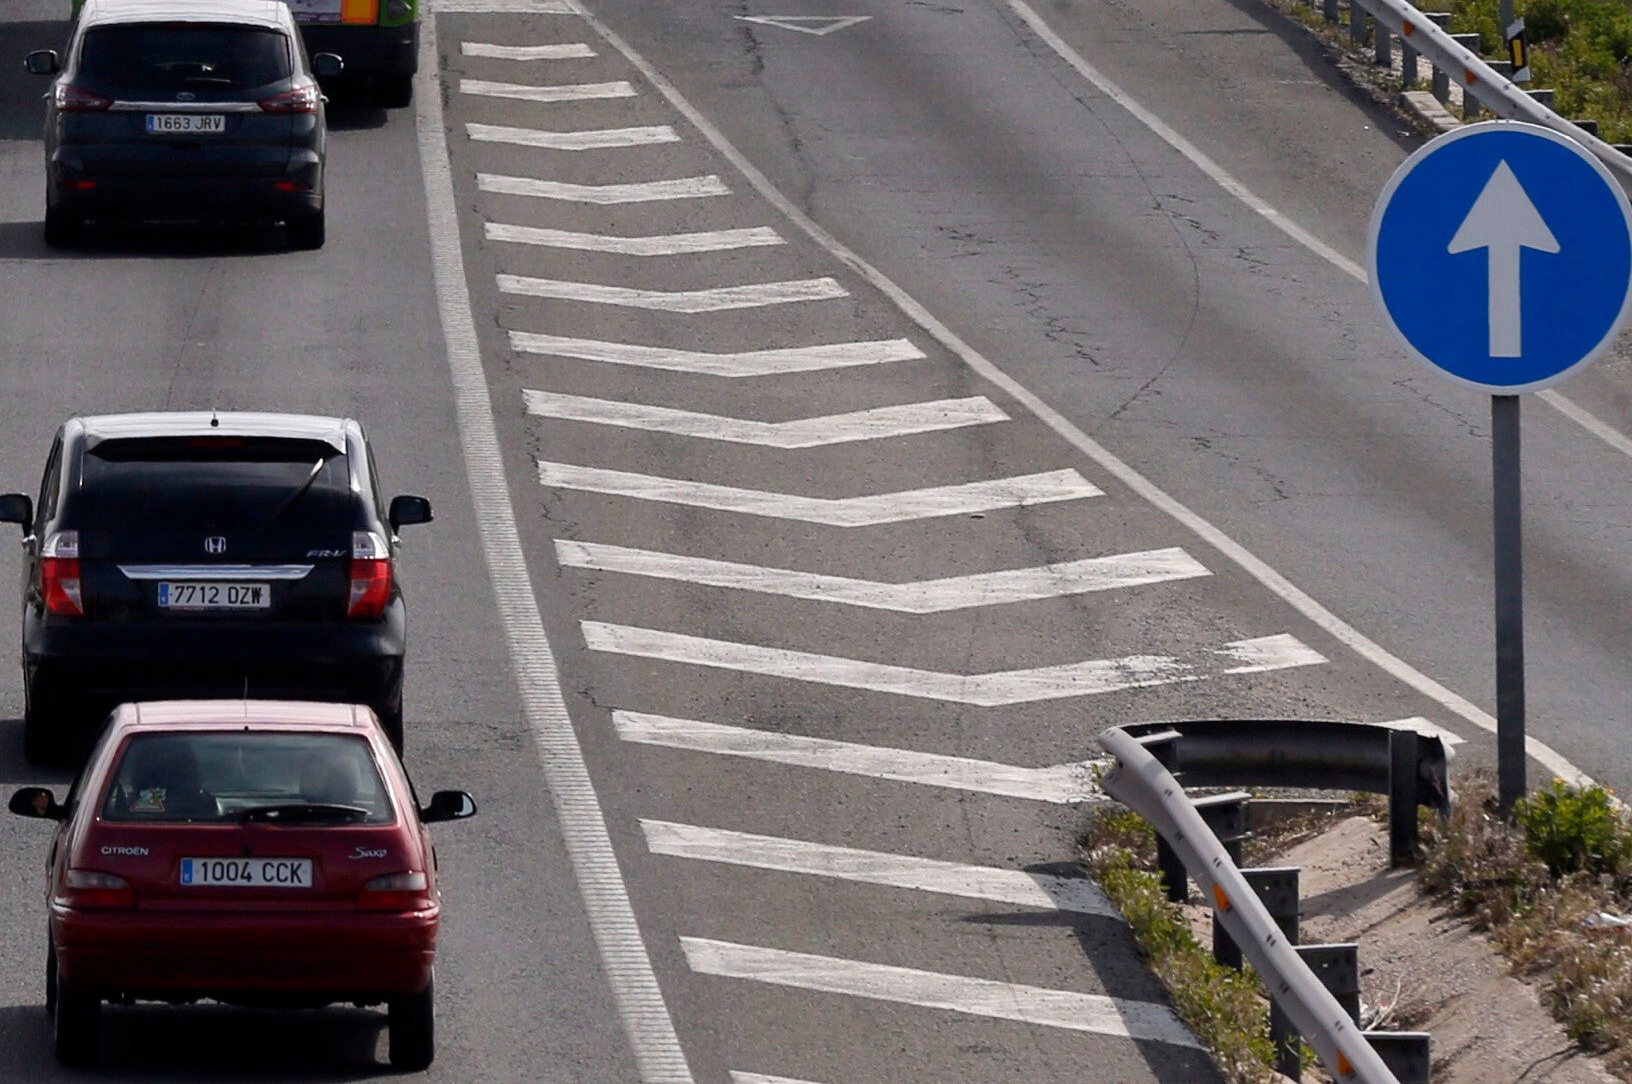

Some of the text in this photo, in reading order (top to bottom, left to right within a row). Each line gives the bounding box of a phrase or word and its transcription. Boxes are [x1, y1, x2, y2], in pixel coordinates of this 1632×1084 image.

[157, 117, 221, 130] 1663 JRV
[174, 585, 262, 605] 7712 DZW
[348, 846, 387, 859] Saxo
[201, 861, 303, 884] 1004 CCK
